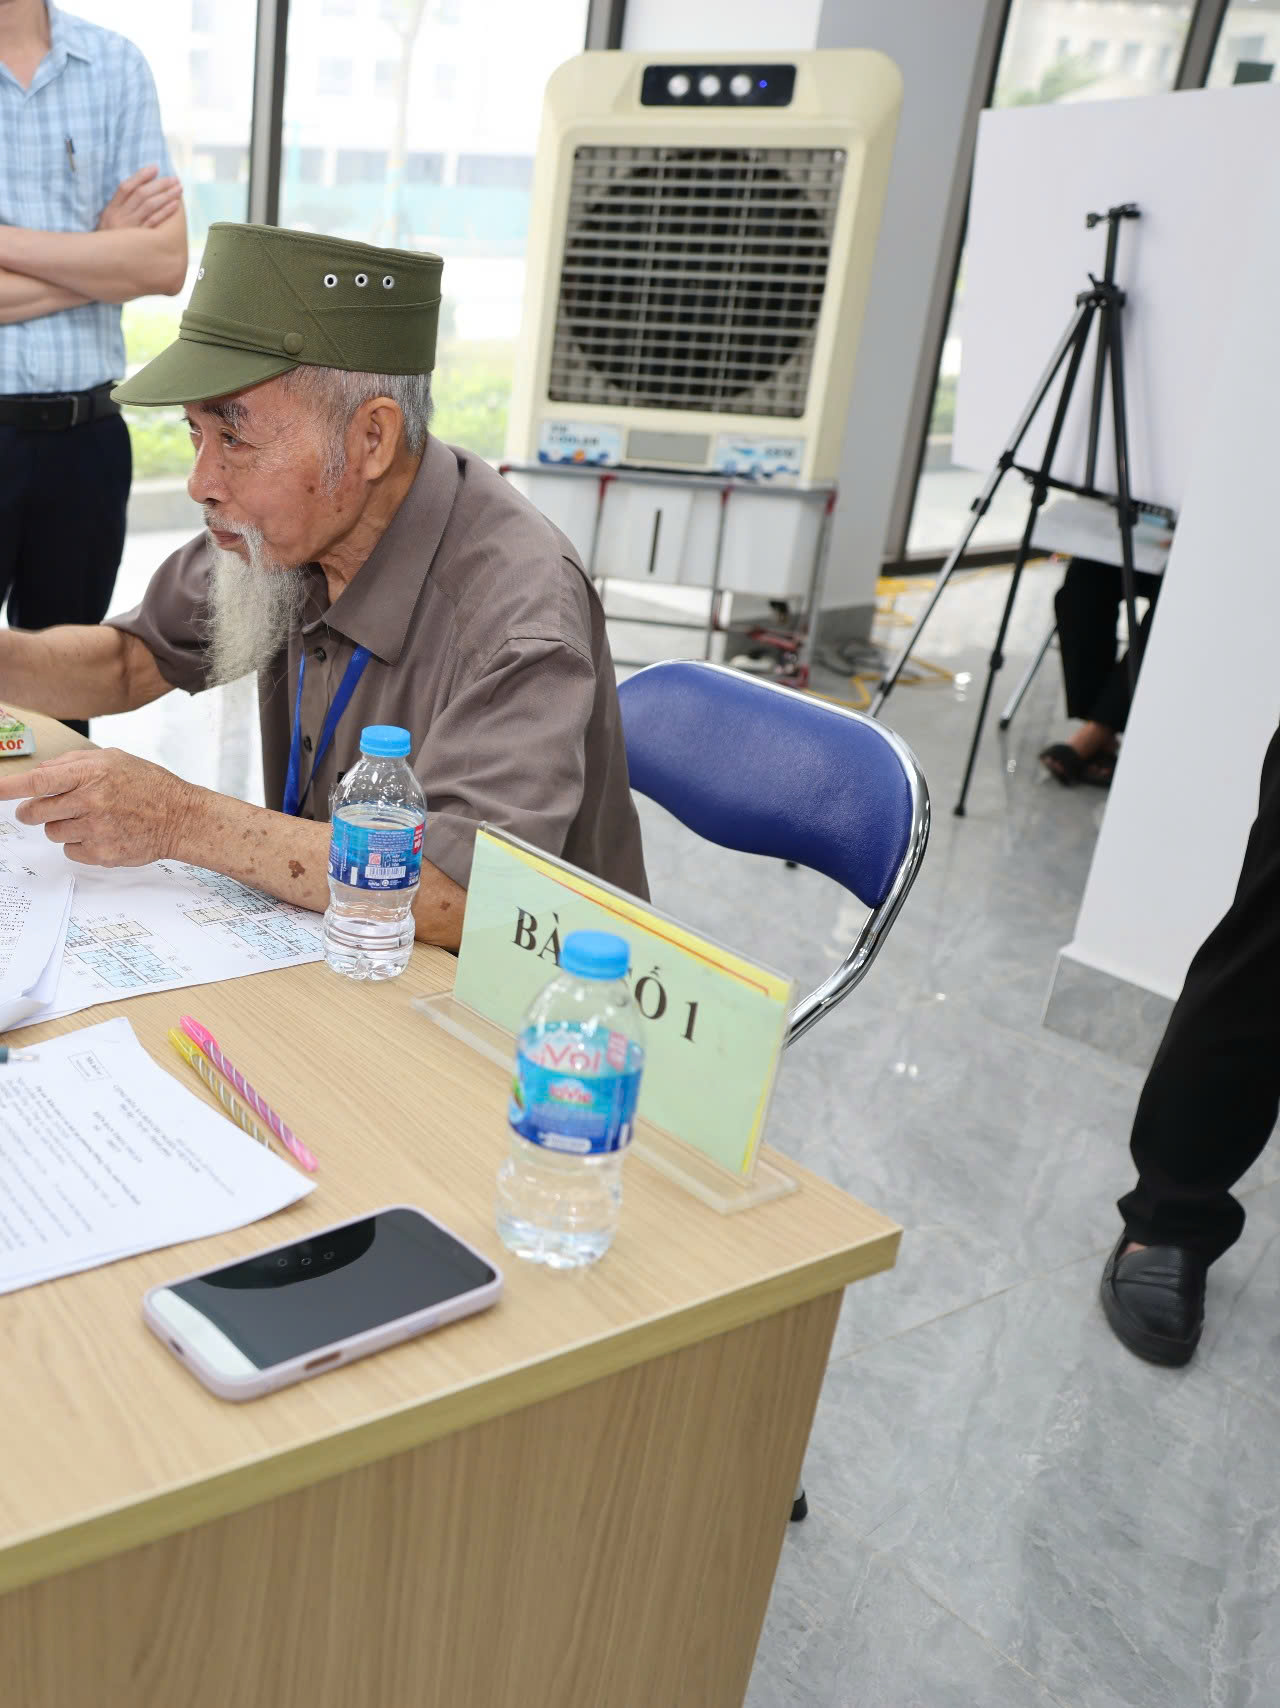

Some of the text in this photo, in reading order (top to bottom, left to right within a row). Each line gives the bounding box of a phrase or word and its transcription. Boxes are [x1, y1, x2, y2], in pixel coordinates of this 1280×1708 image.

[511, 905, 700, 1044] BÀ Ố 1
